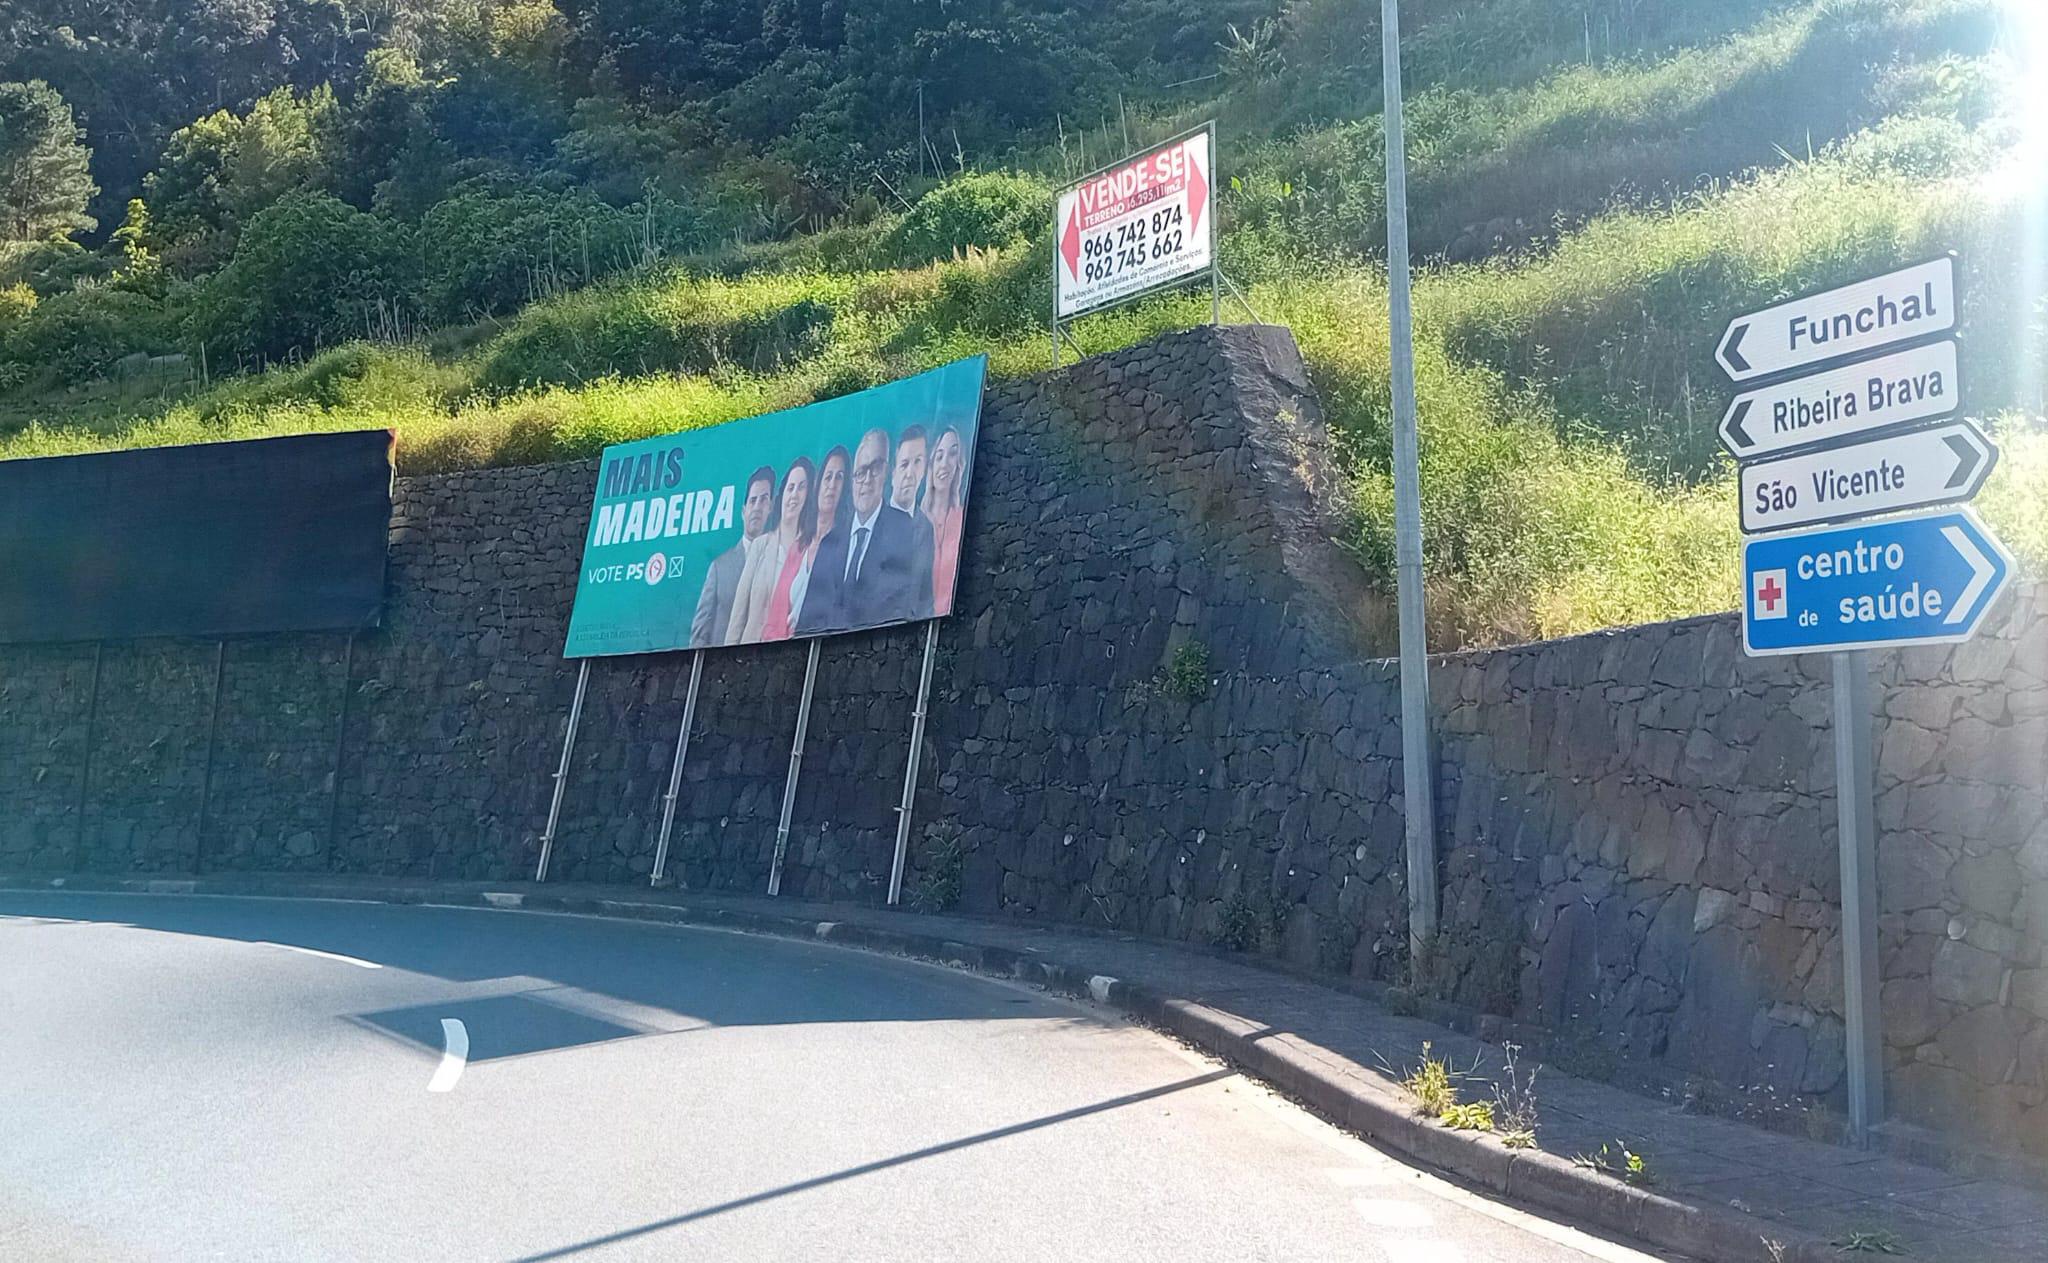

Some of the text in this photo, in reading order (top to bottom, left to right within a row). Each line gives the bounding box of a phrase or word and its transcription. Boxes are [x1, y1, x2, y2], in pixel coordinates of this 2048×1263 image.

[1081, 147, 1183, 214] VENDE-SE
[1084, 202, 1125, 228] TERRENO
[1084, 231, 1113, 261] 966
[1117, 218, 1146, 249] 742
[1152, 204, 1183, 235] 874
[1085, 229, 1183, 285] 962 745 662
[1788, 282, 1936, 351] Funchal
[1773, 370, 1943, 434] Ribeira Brava
[603, 447, 684, 498] MAIS
[1755, 459, 1905, 514] São Vicente
[593, 485, 735, 547] MADEIRA
[588, 562, 645, 584] VOTE PS
[1796, 539, 1905, 581] centro
[1798, 583, 1943, 627] de saúde
